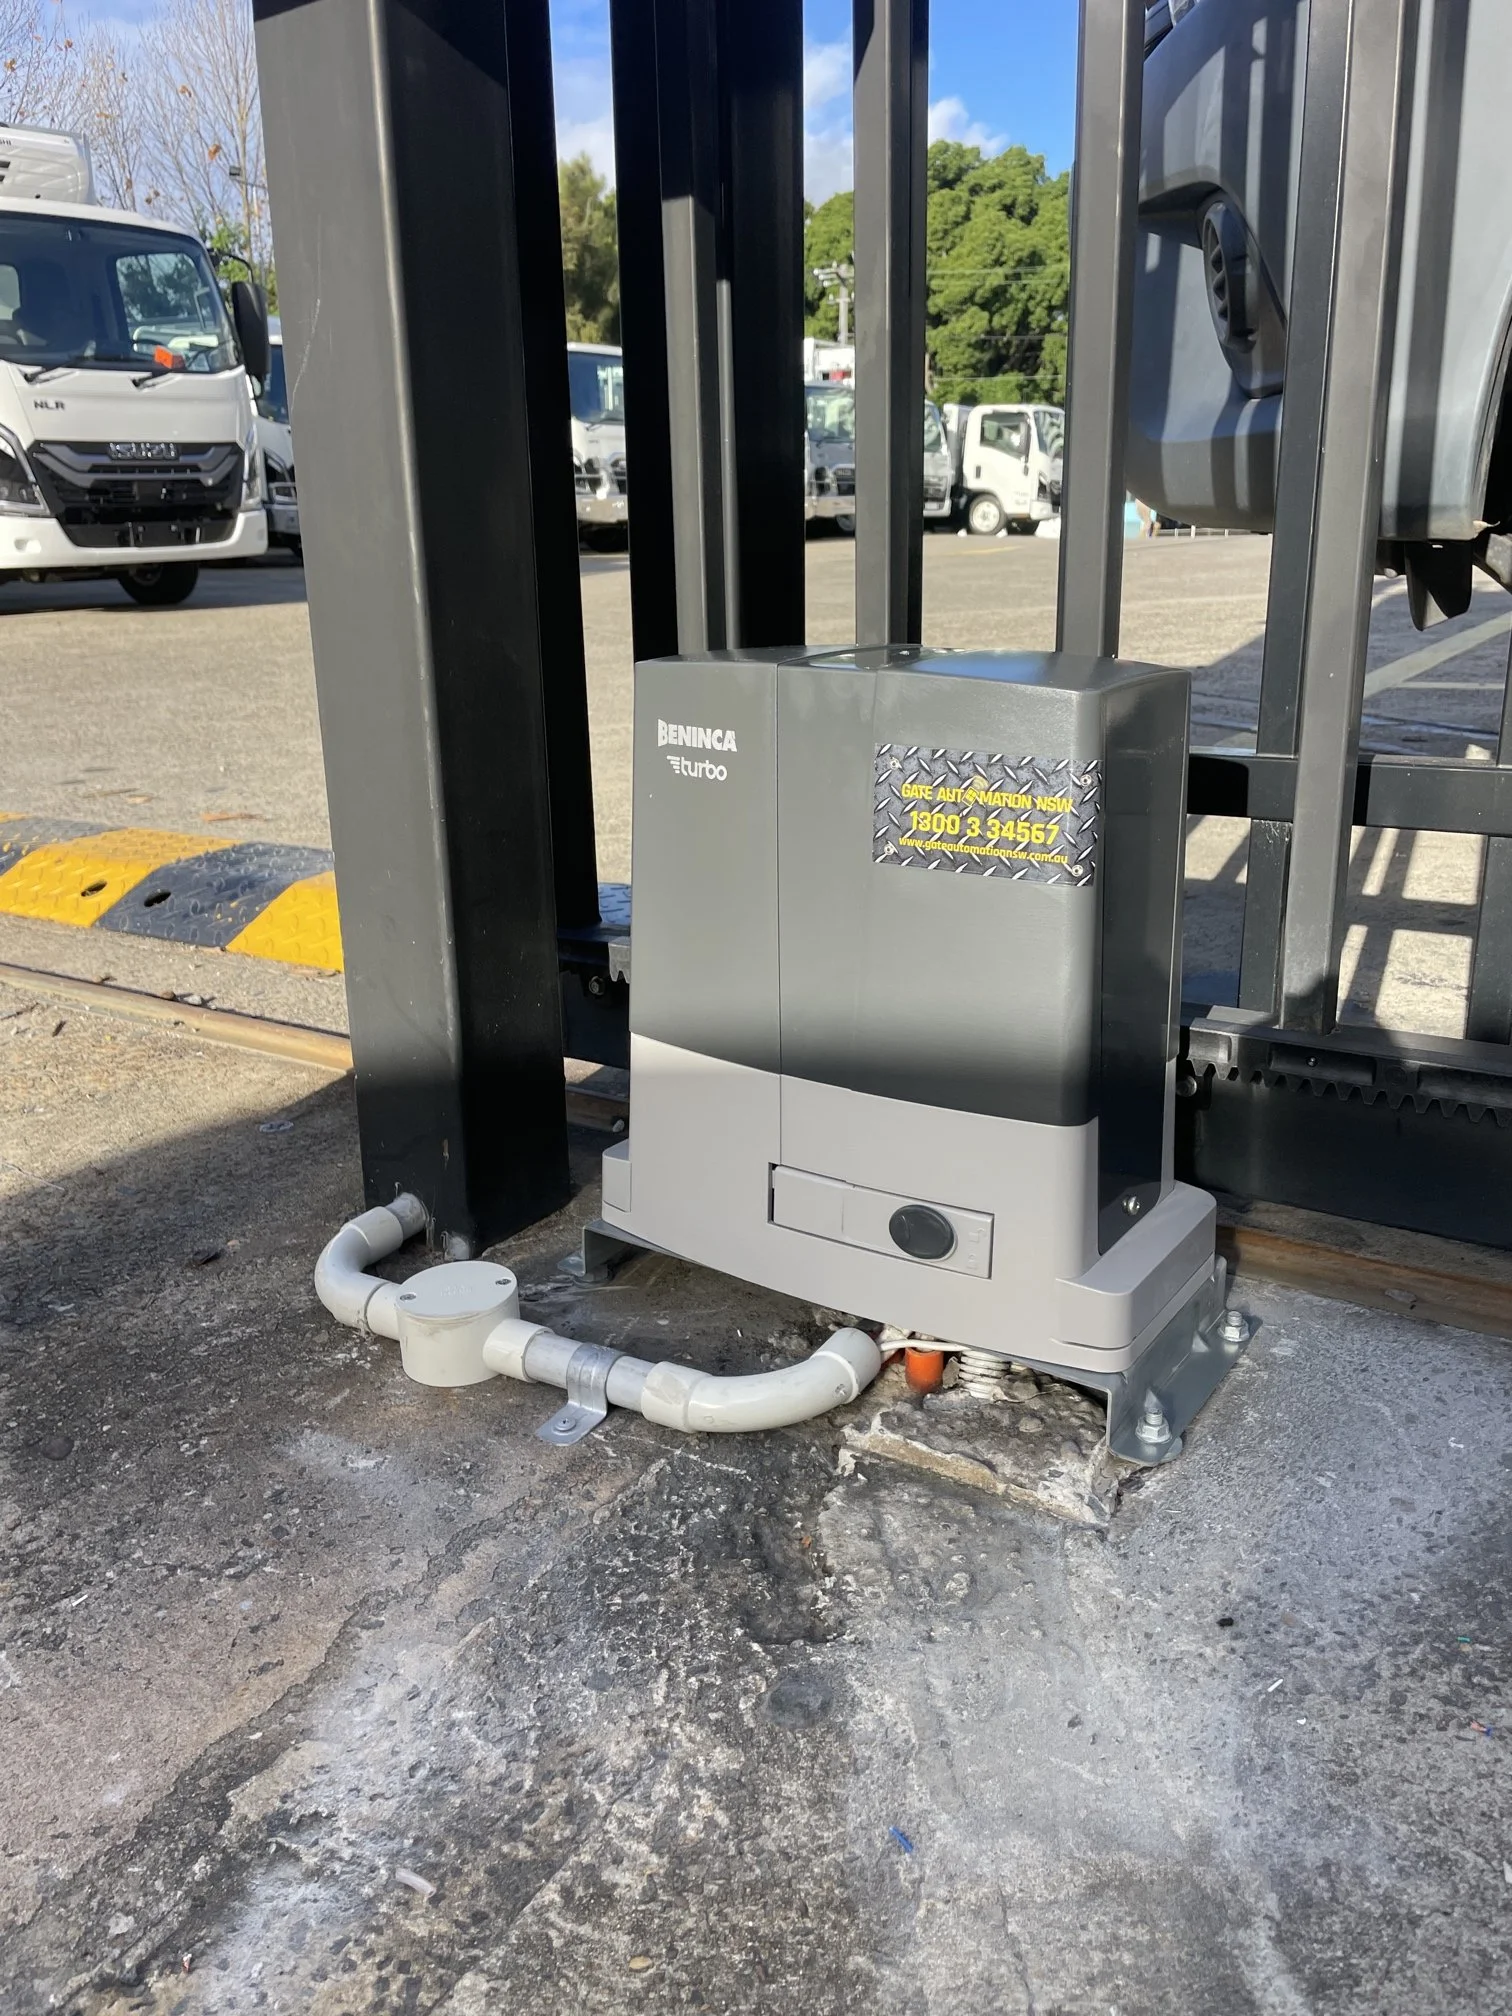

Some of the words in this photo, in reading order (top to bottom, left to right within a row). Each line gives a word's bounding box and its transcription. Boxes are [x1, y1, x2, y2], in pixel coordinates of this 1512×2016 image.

[680, 756, 728, 781] turbo
[901, 783, 933, 801] GATE
[1036, 797, 1073, 813] NSW
[909, 811, 960, 835] 1300
[966, 816, 981, 837] 3
[986, 819, 1060, 845] 34567
[898, 837, 1068, 864] www.gateautomationnsw.com.au
